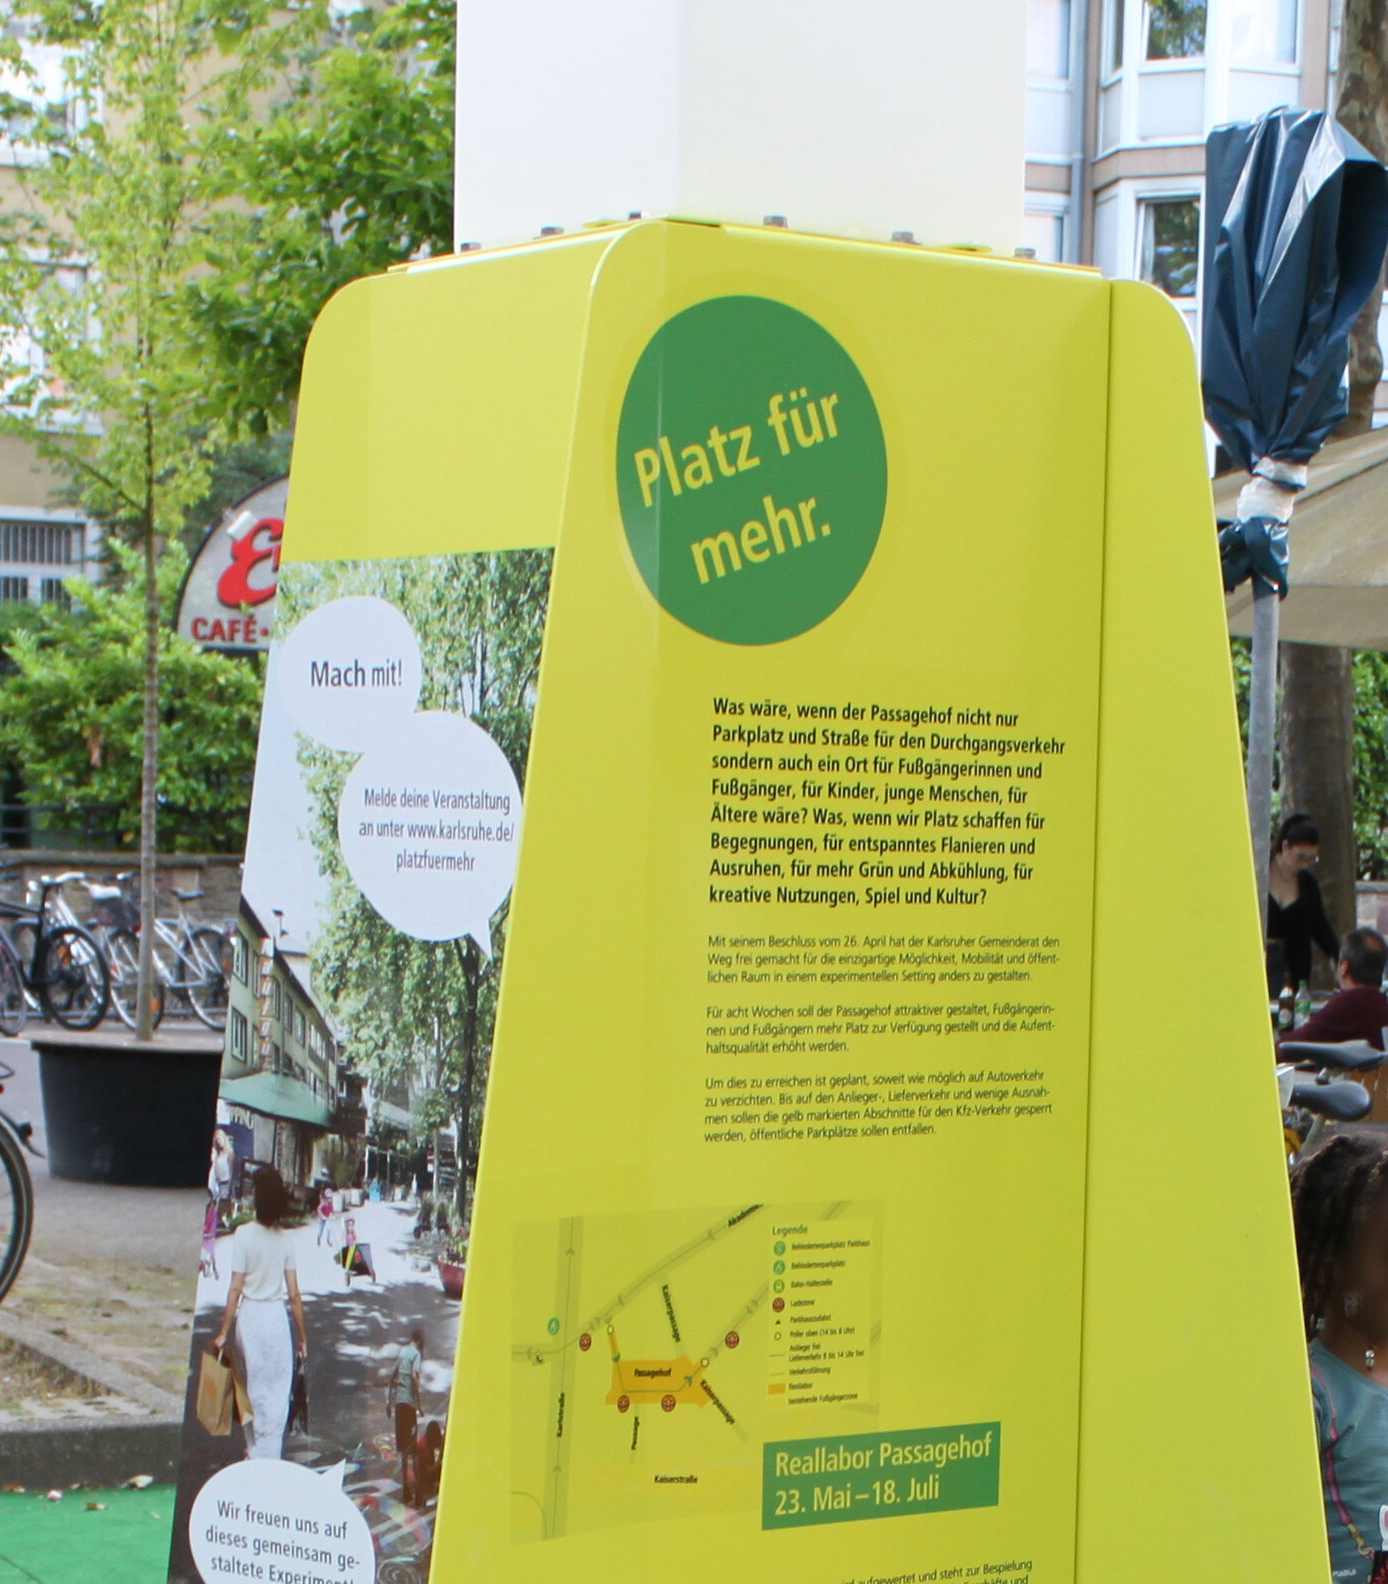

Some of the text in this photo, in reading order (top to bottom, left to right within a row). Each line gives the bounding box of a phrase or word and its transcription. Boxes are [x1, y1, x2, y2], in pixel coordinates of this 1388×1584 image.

[634, 387, 839, 508] Platz für
[690, 495, 832, 584] mehr.
[191, 614, 257, 643] CAFÉ
[311, 658, 401, 687] Mach mit!
[713, 697, 1018, 727] Was wäre, wenn der Passagehof nicht nur
[713, 724, 1065, 756] Parkplatz und Straße für den Durchgangsverkehr
[712, 751, 1042, 781] sondern auch ein Ort für Fußgängerinnen und
[364, 787, 510, 816] Melde deine Veranstaltung
[712, 777, 1027, 805] Fußgänger, für Kinder, junge Menschen, für
[710, 802, 1045, 829] Ältere wäre? Was, wenn wir Platz schaffen für
[358, 819, 514, 842] an unter www.karlsruhe.de/
[710, 831, 1035, 856] Begegnungen, für entspanntes Flanieren und
[396, 848, 475, 872] platzfuermehr
[709, 858, 1033, 884] Ausruhen, für mehr Grün und Abkühlung, für
[709, 884, 987, 908] kreative Nutzungen, Spiel und Kultur?
[706, 1002, 1054, 1019] Für acht Wochen soll der Passagehof attraktiver gestaltet, Fußgängerin-
[705, 1039, 849, 1056] haltsqualität erhöht werden.
[703, 1122, 936, 1142] werden, öffentliche Parkplätze sollen entfallen.
[772, 1224, 808, 1237] Legende
[700, 1379, 735, 1425] Kaiserpassage
[775, 1430, 992, 1477] Reallabor Passagehof
[774, 1488, 805, 1515] 23.
[813, 1482, 851, 1511] Mai
[872, 1479, 900, 1504] 18.
[906, 1473, 939, 1502] Juli
[216, 1499, 347, 1539] Wir freuen uns auf
[205, 1524, 360, 1572] dieses gemeinsam ge-
[211, 1555, 263, 1579] staltete
[918, 1568, 937, 1582] und
[939, 1567, 963, 1580] steht
[965, 1566, 980, 1577] zur
[982, 1559, 1032, 1575] Bespielung
